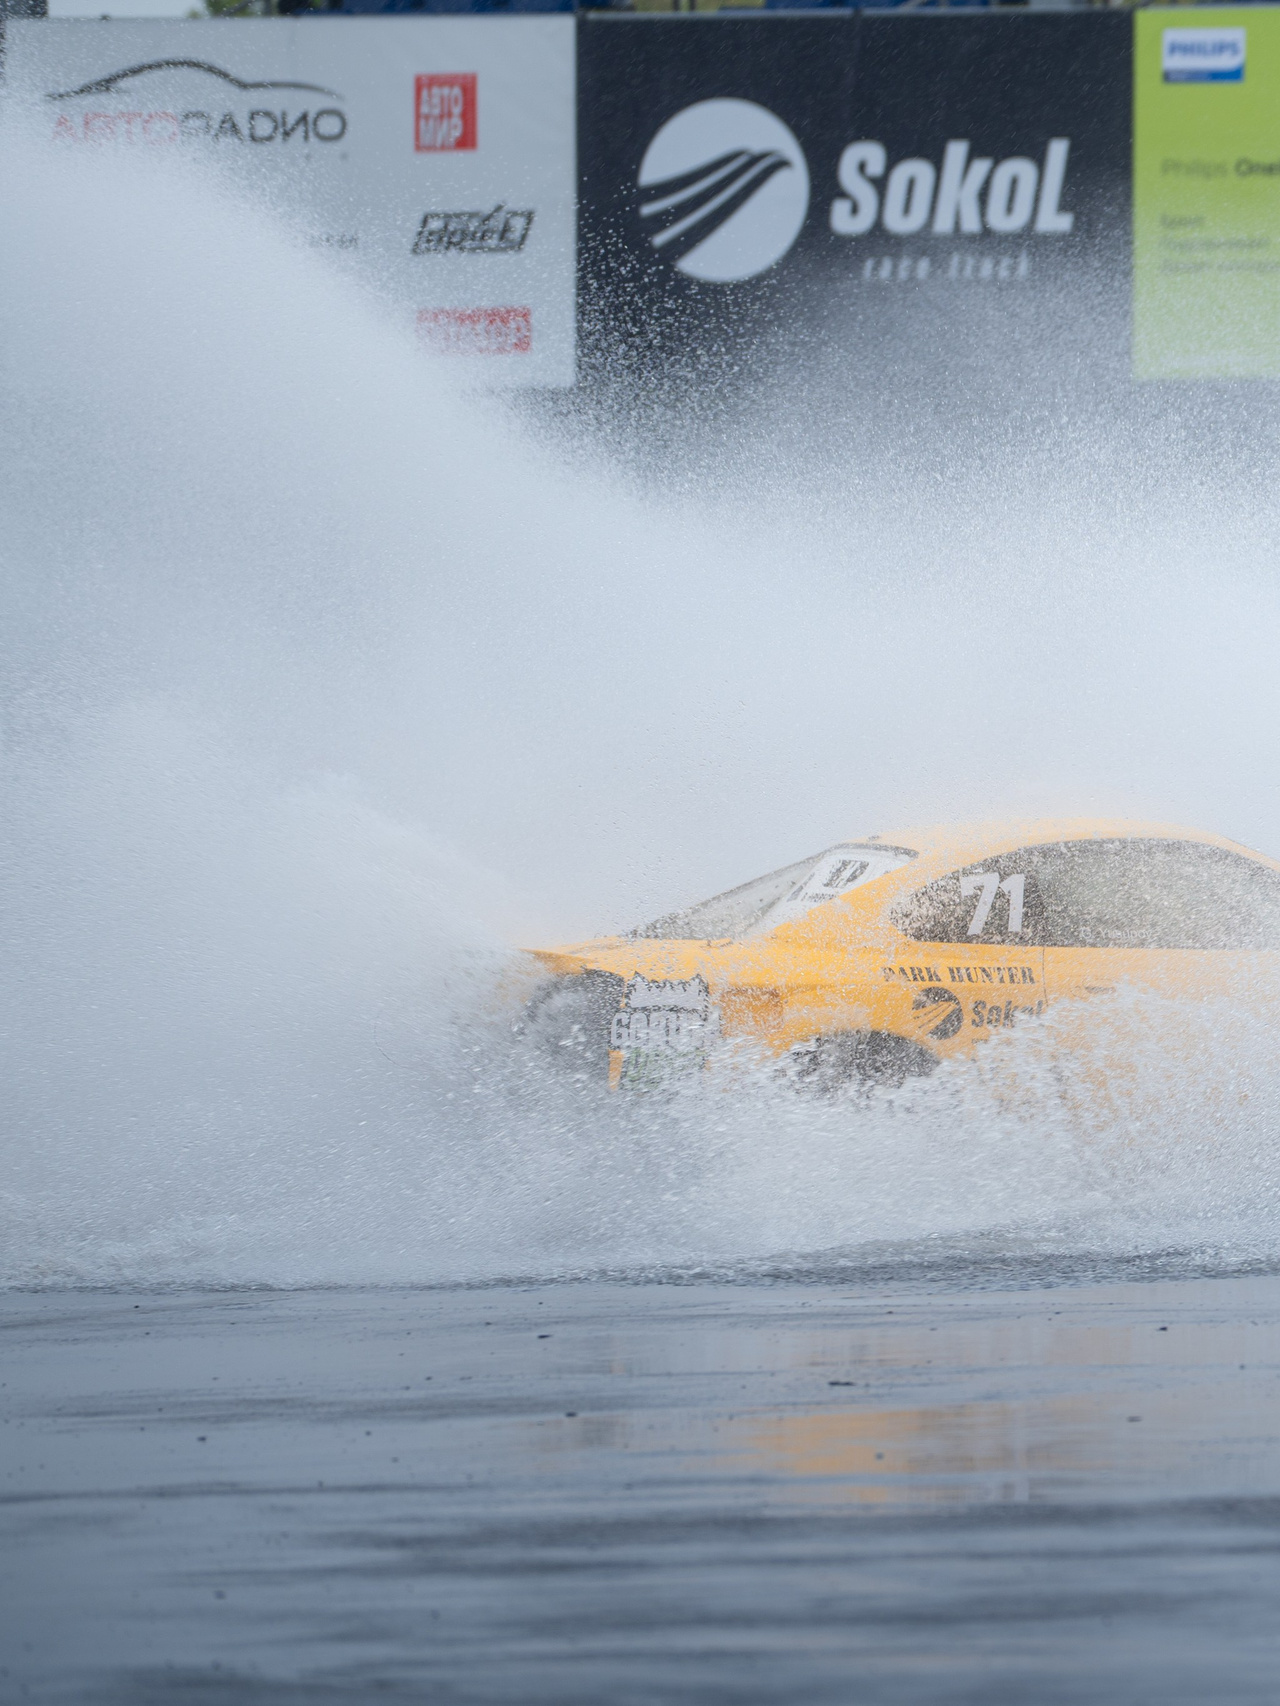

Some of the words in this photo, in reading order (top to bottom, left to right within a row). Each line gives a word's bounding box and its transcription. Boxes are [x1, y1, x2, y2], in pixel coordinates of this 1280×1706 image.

[1168, 40, 1239, 57] PHILIPS
[420, 86, 464, 115] АВТО
[419, 117, 464, 149] МИР
[959, 872, 1025, 936] 71
[947, 966, 1036, 984] HUNTER
